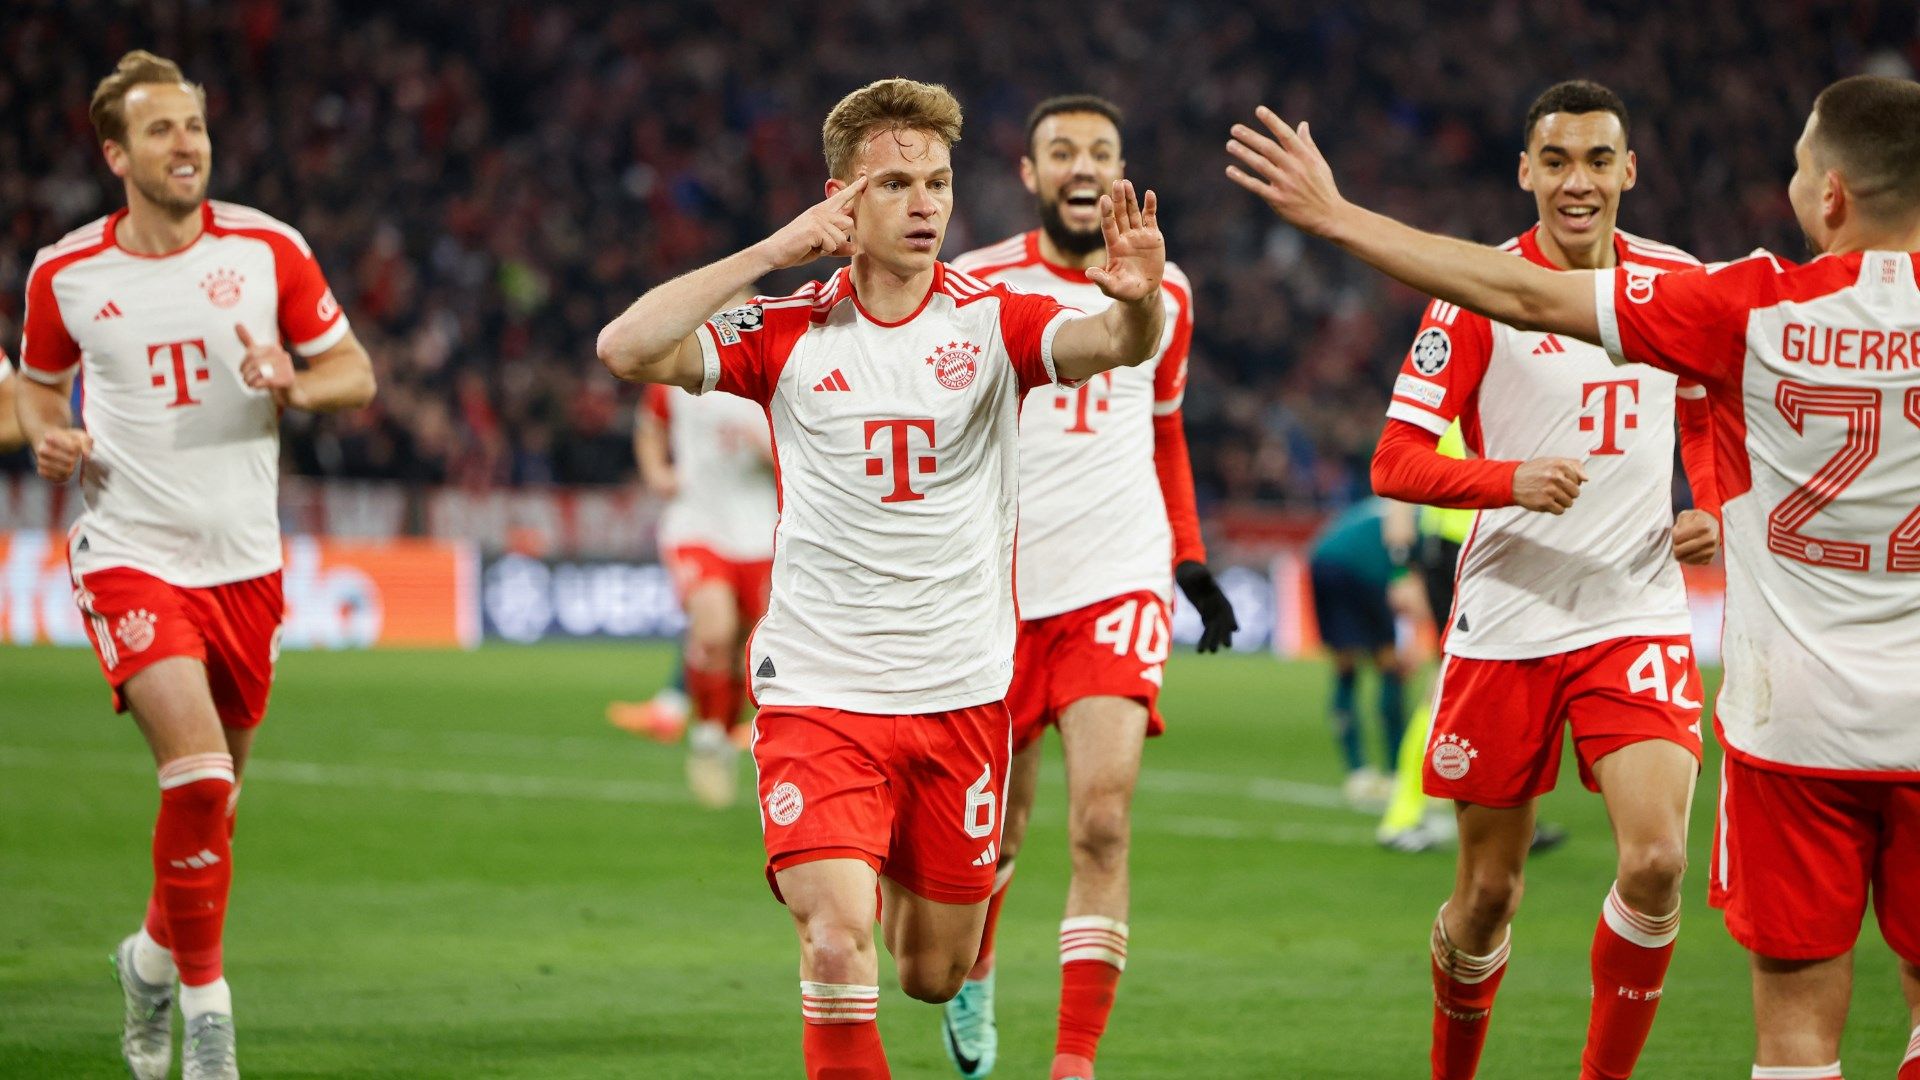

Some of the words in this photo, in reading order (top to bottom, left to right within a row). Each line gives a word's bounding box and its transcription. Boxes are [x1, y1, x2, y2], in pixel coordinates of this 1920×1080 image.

[946, 351, 974, 365] BAYERN
[1579, 379, 1639, 455] T
[864, 419, 936, 503] T
[1767, 379, 1920, 572] 2
[555, 562, 688, 637] UEF
[1094, 599, 1169, 664] 40
[1626, 642, 1703, 710] 42
[964, 762, 996, 838] 6
